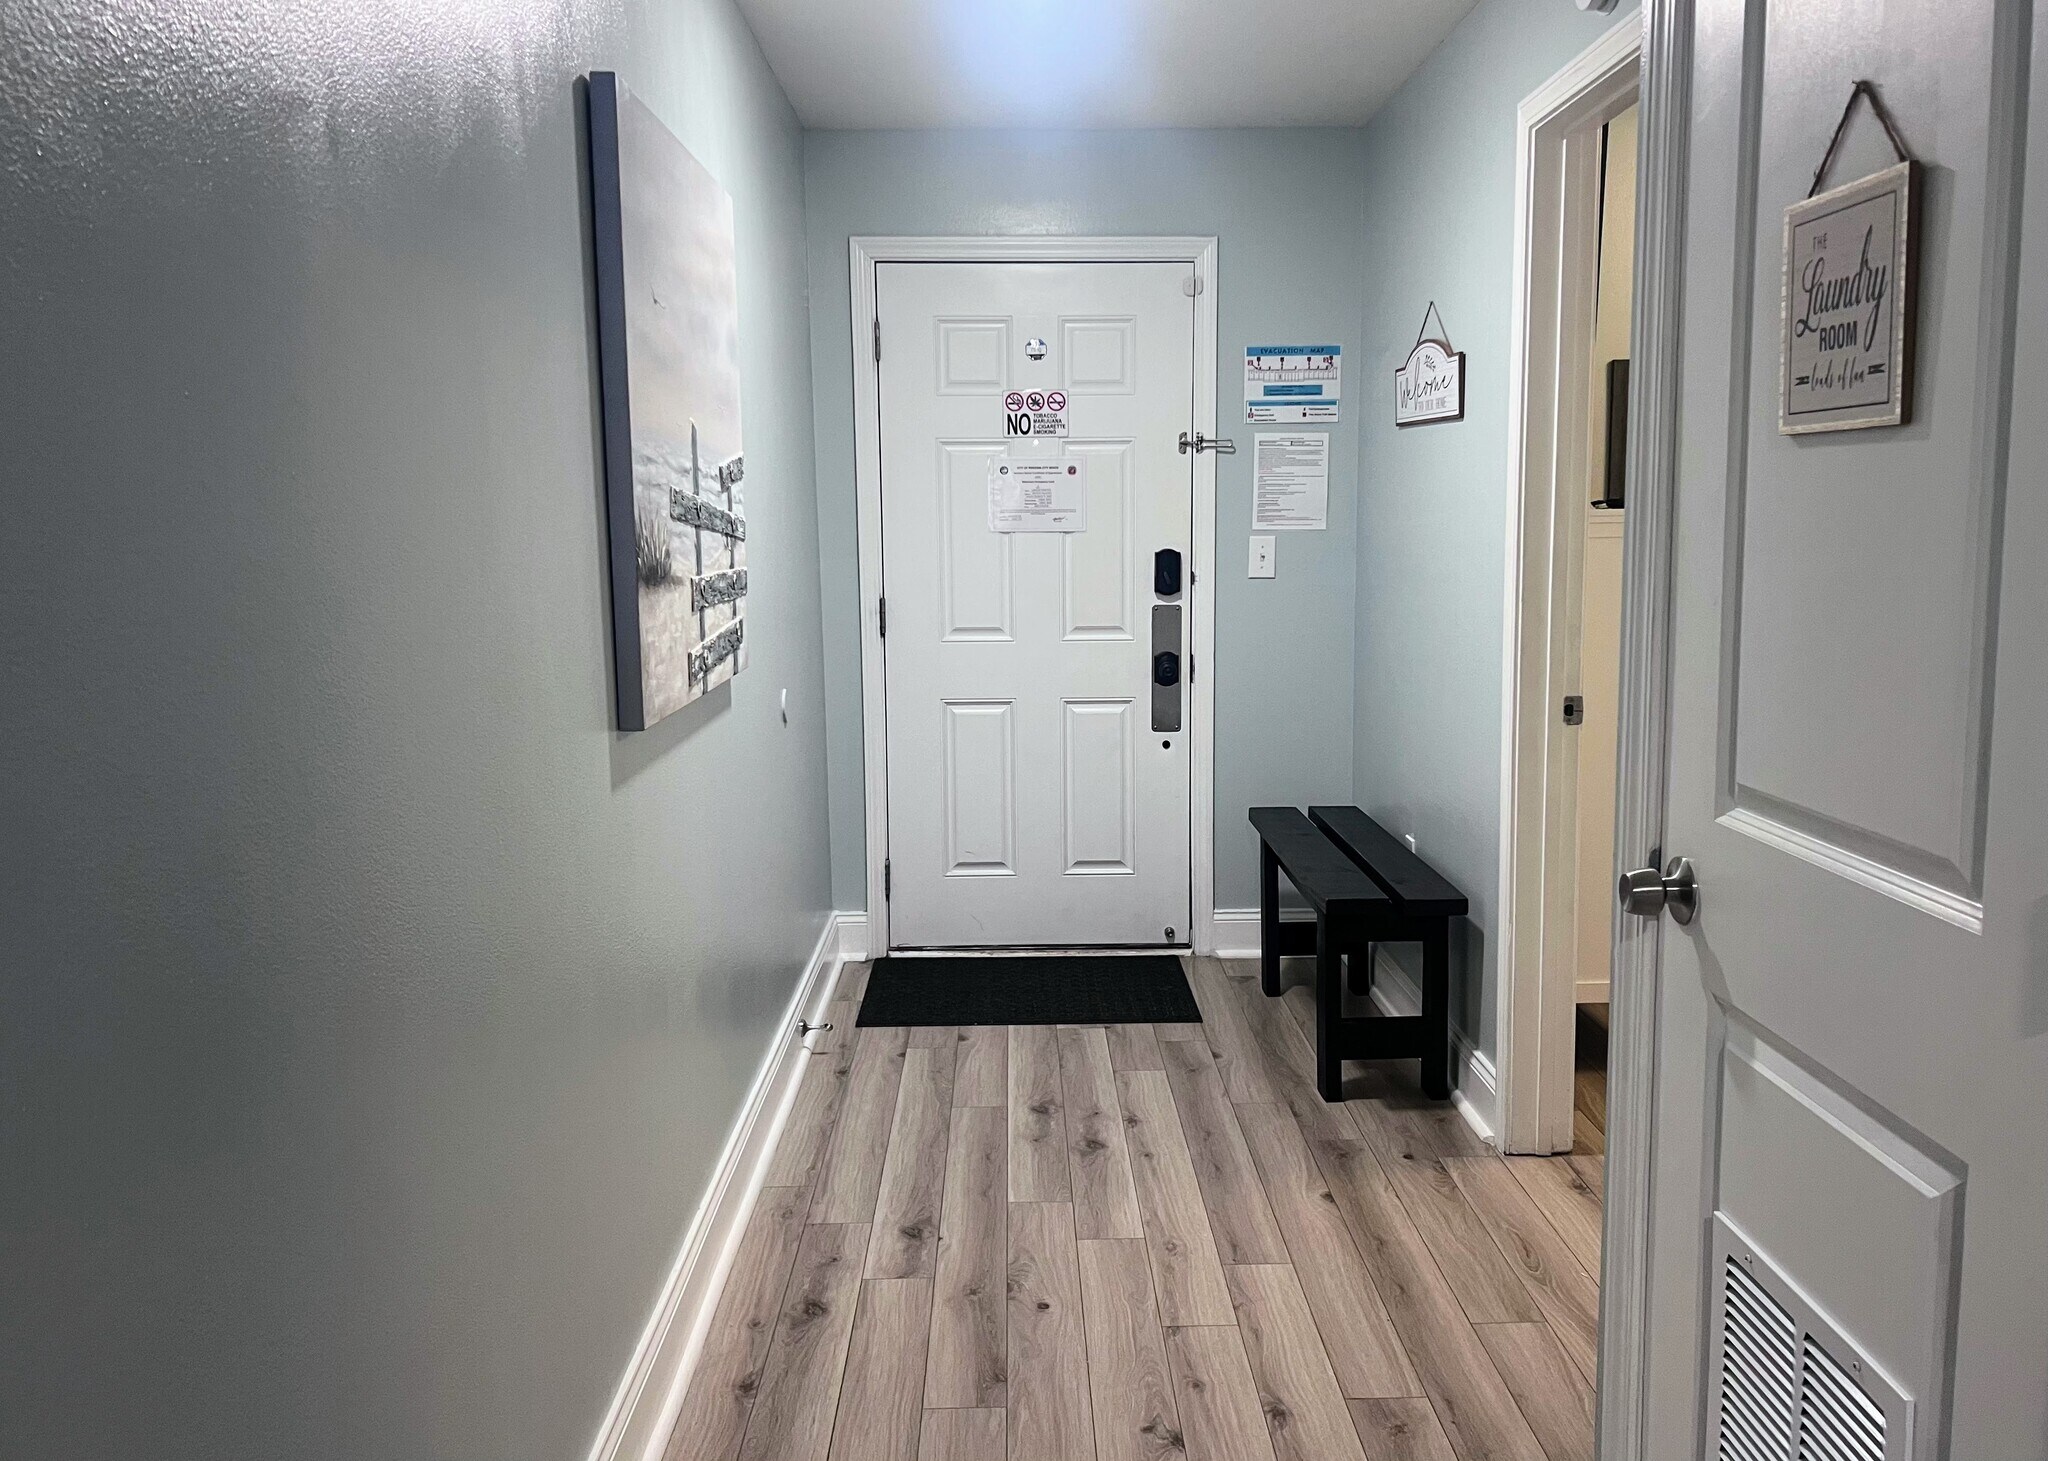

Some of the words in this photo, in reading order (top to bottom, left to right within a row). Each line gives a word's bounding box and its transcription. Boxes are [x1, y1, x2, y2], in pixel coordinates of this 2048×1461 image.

[1812, 232, 1827, 251] THE
[1794, 224, 1888, 352] Laundry
[1819, 320, 1858, 352] ROOM
[1260, 347, 1304, 355] EVACUATION
[1399, 356, 1454, 411] Welcome
[1006, 413, 1031, 435] NO
